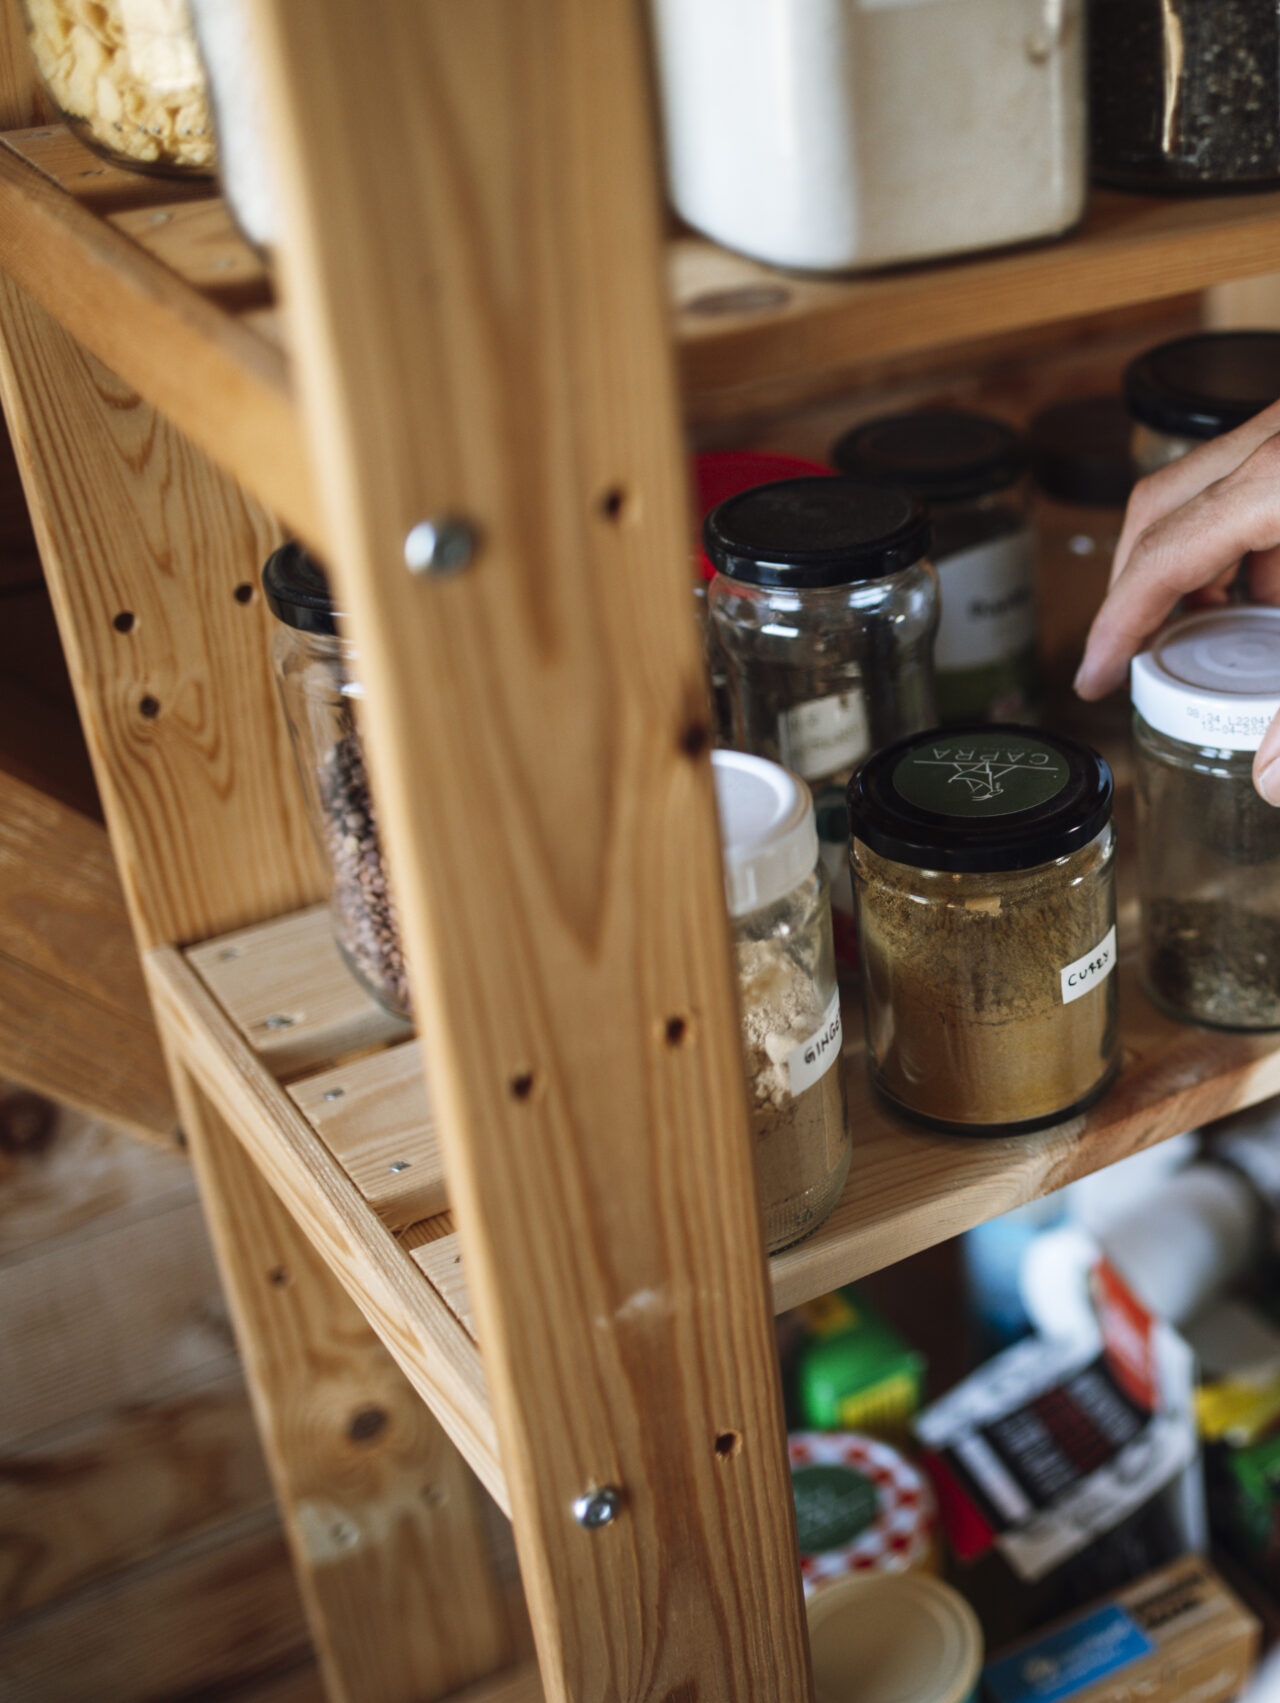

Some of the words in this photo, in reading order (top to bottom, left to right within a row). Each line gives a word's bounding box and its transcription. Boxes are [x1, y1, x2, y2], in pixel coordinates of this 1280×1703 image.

[932, 748, 1049, 765] CAPRA
[1067, 949, 1109, 987] CURRY
[804, 1013, 840, 1065] GINGE
